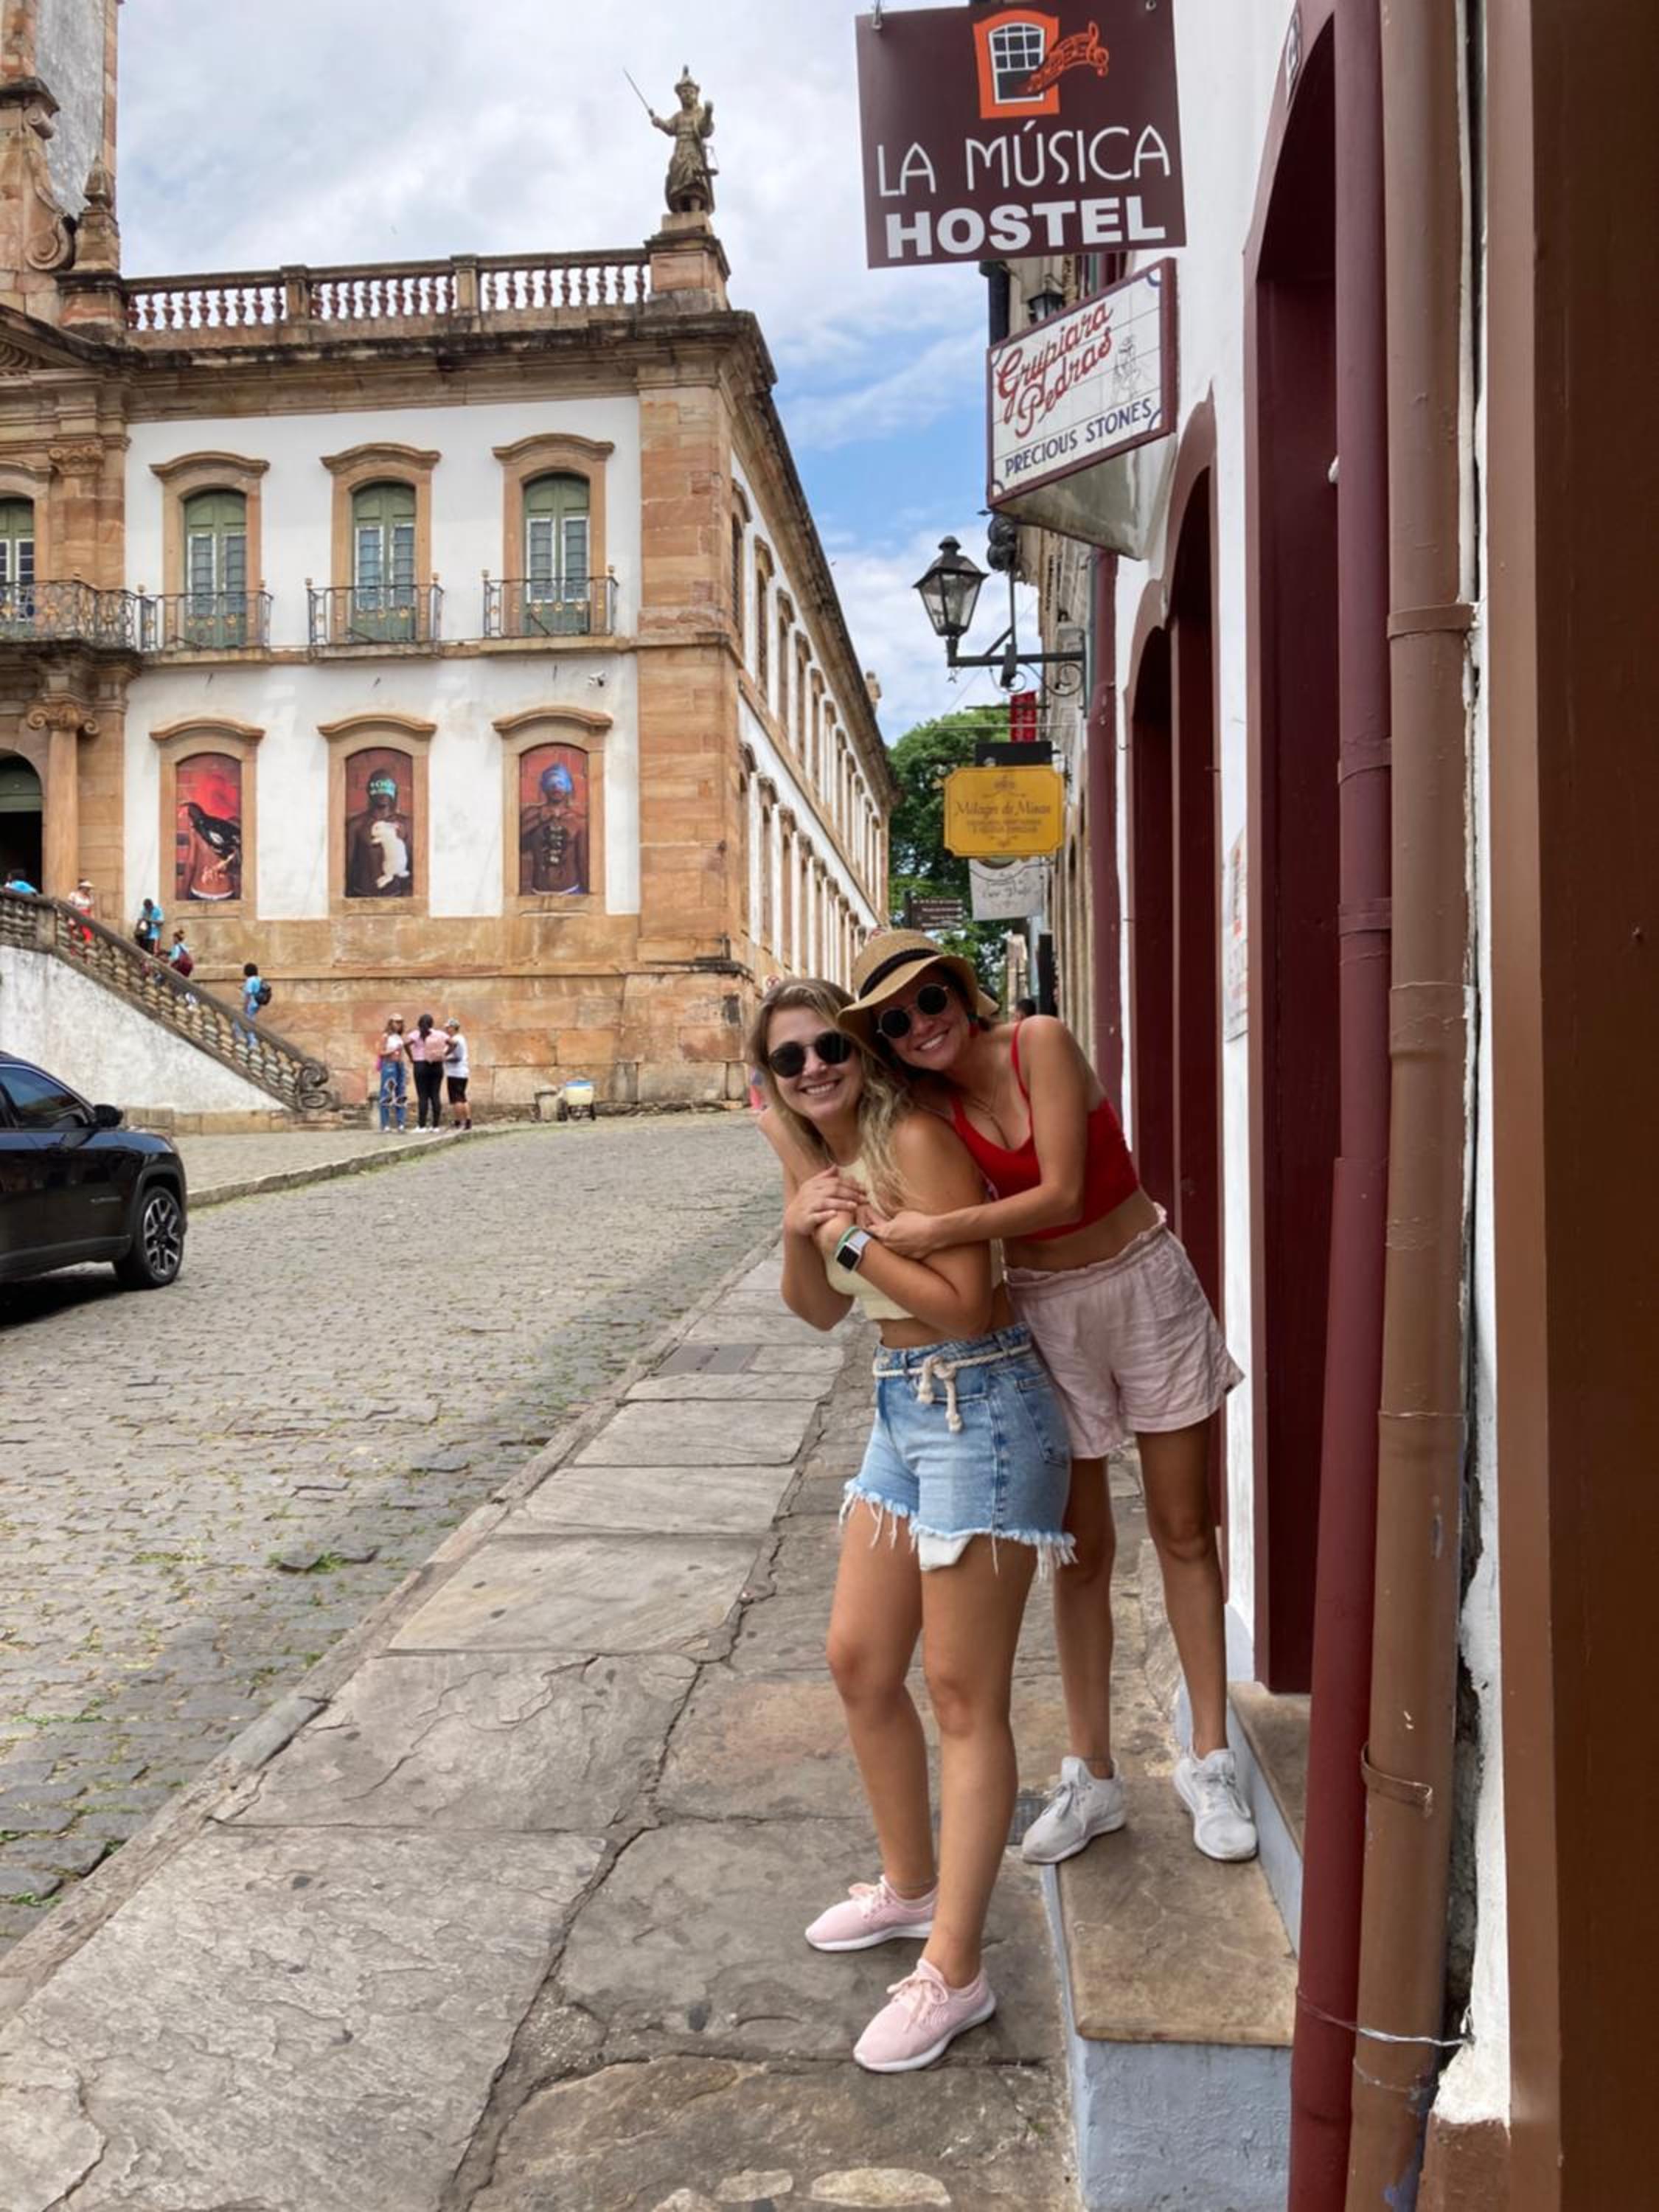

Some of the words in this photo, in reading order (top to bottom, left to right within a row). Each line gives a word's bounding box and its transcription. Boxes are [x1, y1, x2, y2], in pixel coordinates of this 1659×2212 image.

[877, 142, 936, 197] LA
[965, 120, 1170, 191] MÚSICA
[886, 196, 1166, 259] HOSTEL
[996, 302, 1113, 425] Grupiara
[1015, 327, 1112, 438] Pedras
[1005, 430, 1078, 478] PRECIOUS
[1086, 398, 1152, 443] STONES
